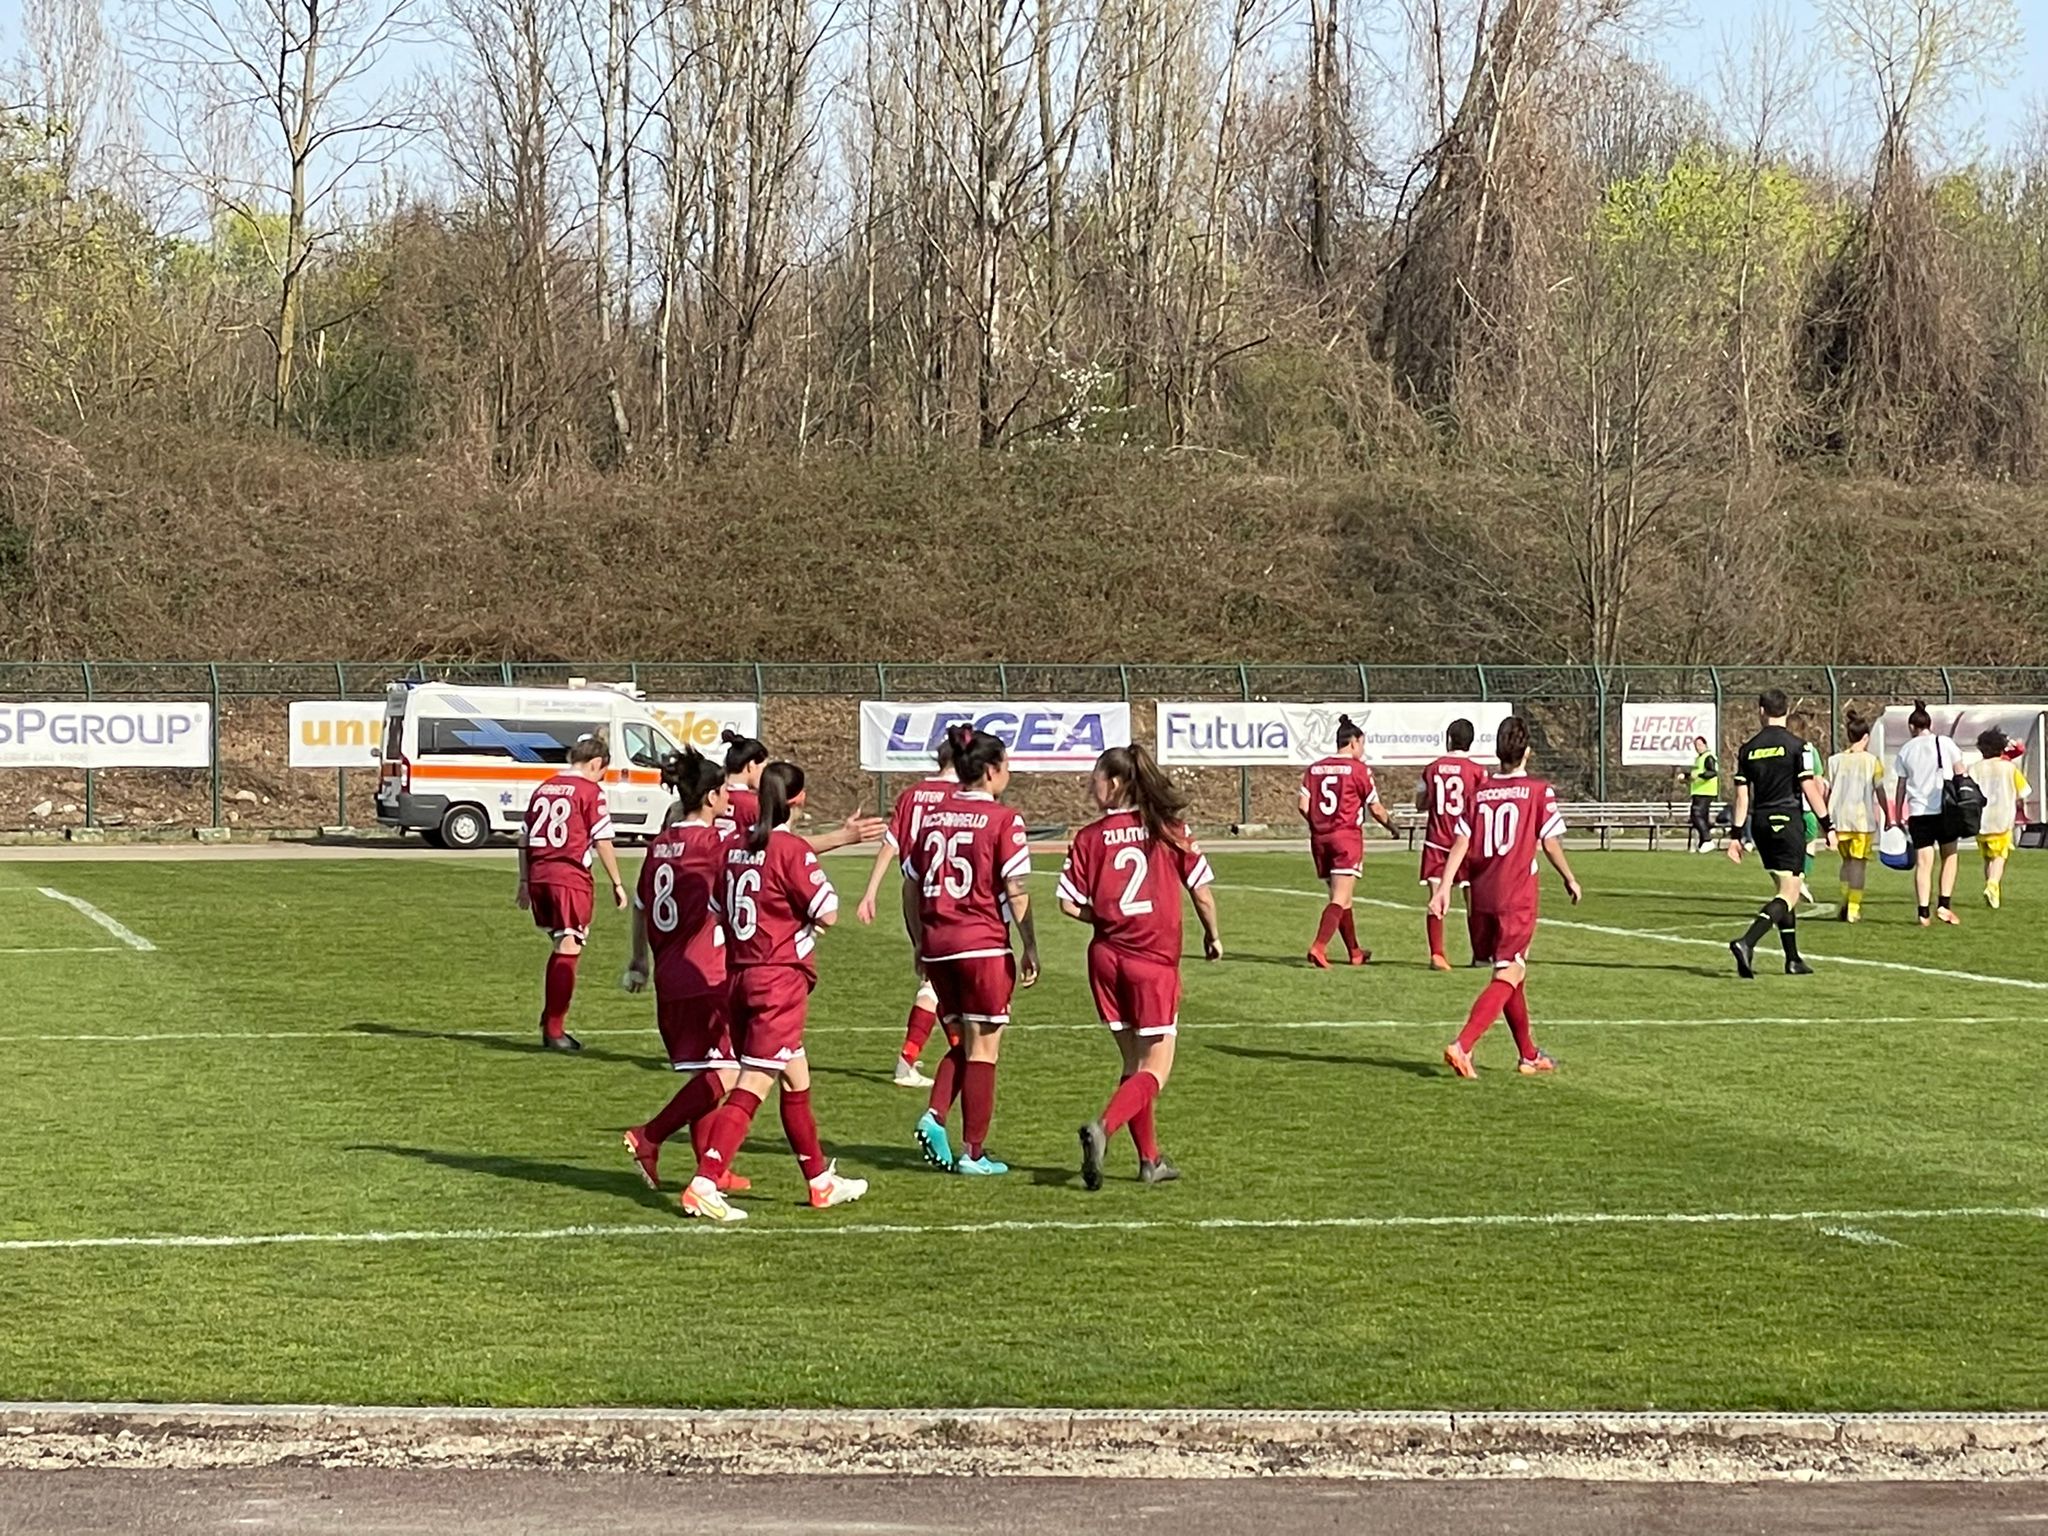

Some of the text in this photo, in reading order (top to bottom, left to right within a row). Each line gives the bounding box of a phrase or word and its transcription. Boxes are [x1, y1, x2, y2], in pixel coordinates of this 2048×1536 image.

[886, 713, 1105, 751] LEGEA
[1167, 712, 1288, 749] Futura
[1629, 735, 1694, 751] ELECAR
[1633, 716, 1697, 733] LIFT-TEK
[1319, 776, 1338, 816] 5
[1434, 775, 1465, 816] 13
[529, 797, 571, 848] 28
[1479, 802, 1519, 858] 10
[923, 831, 974, 899] 25
[1114, 847, 1153, 917] 2
[653, 863, 679, 932] 8
